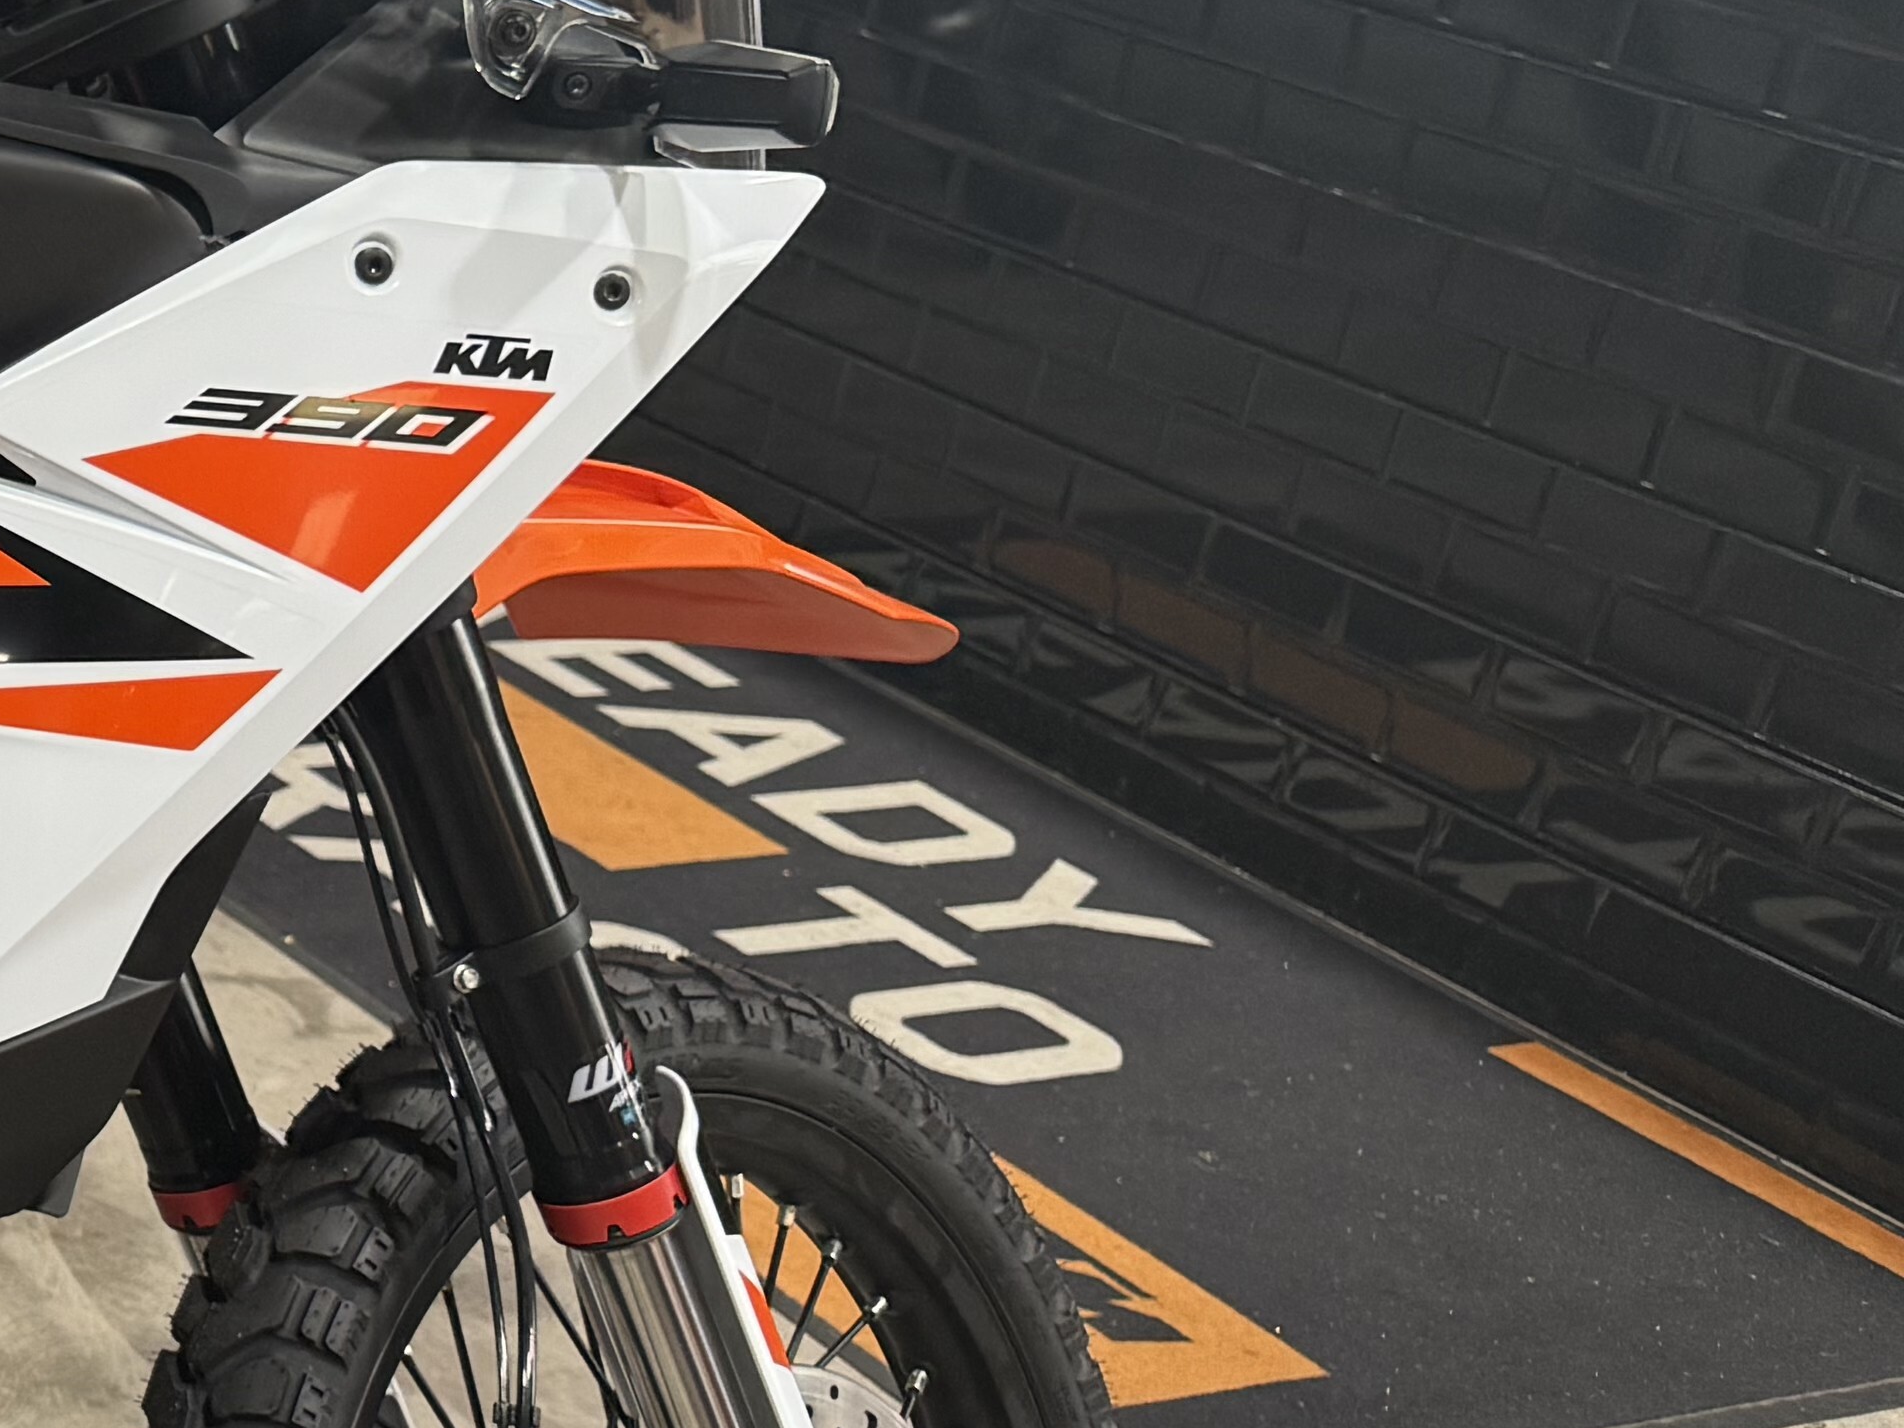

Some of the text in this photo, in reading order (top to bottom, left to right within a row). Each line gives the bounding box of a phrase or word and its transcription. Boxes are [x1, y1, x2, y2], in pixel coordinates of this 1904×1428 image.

[165, 388, 490, 448] 390
[433, 334, 554, 381] KTM
[490, 638, 1215, 948] EADY
[713, 885, 1124, 1086] TO
